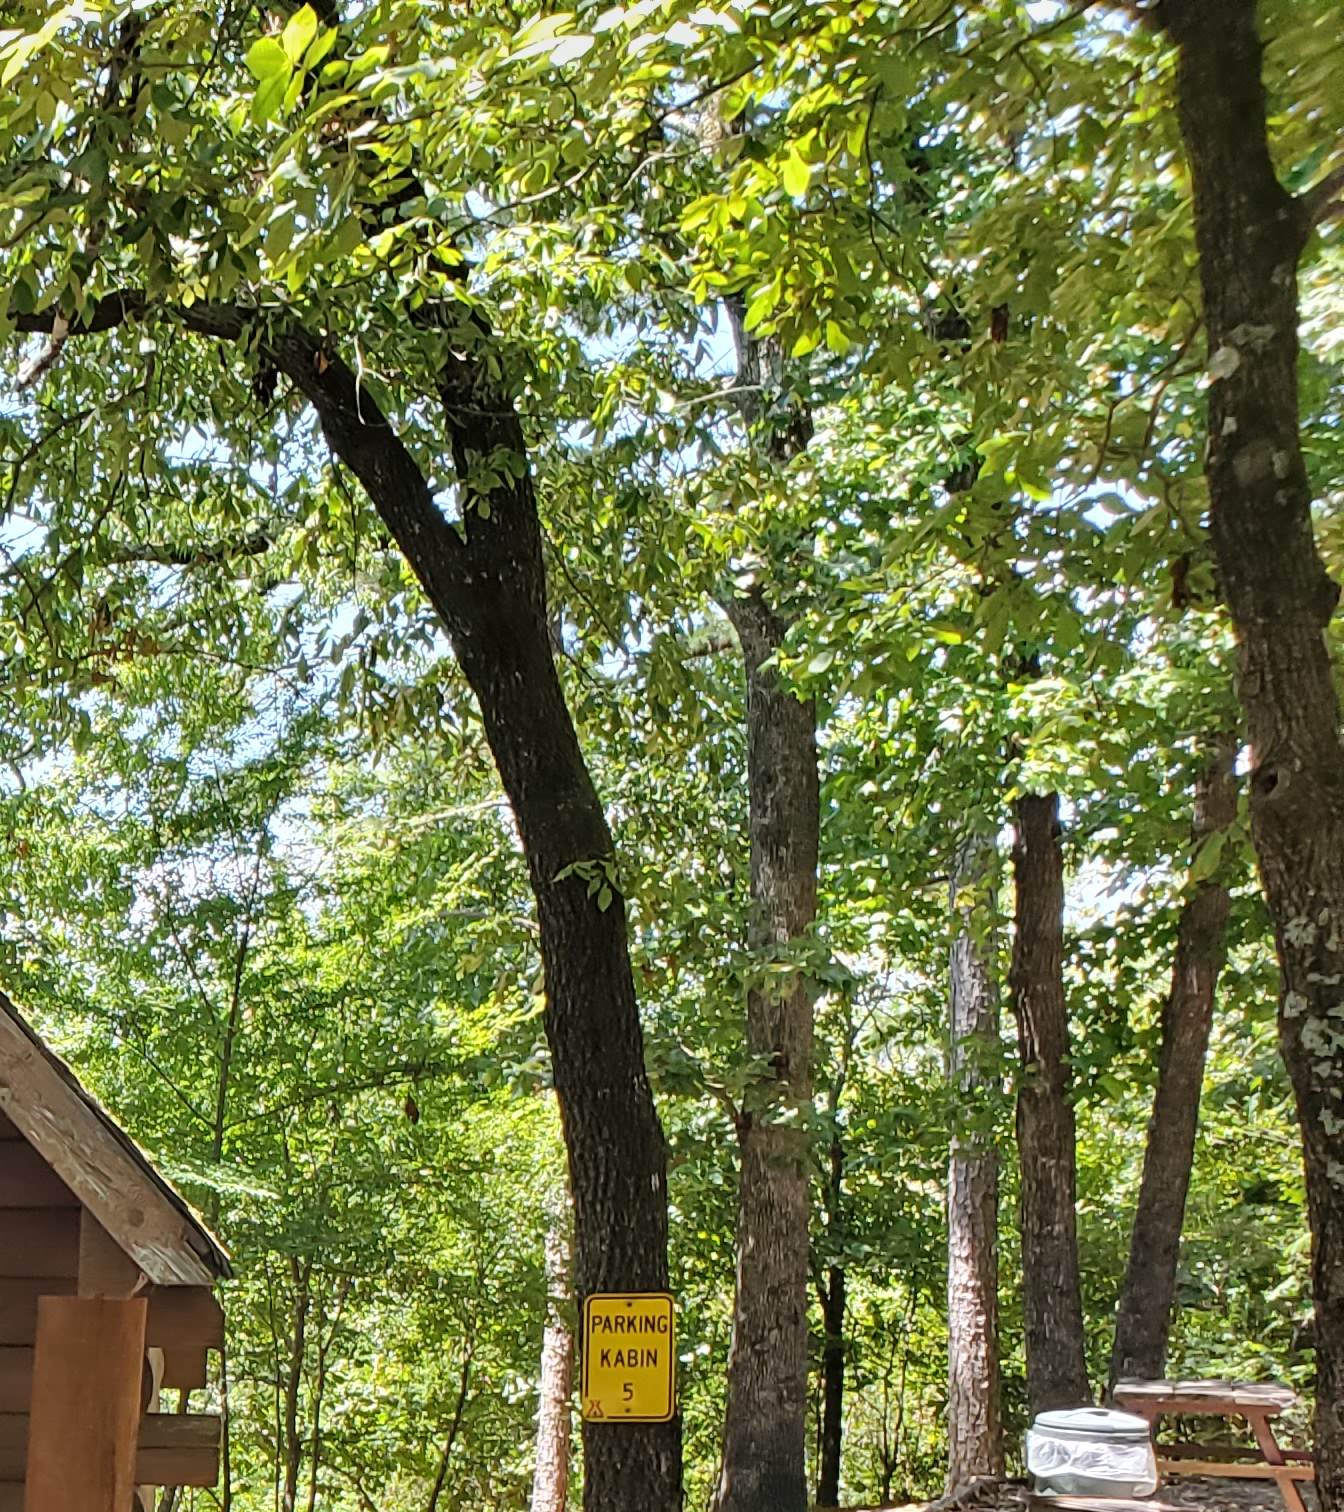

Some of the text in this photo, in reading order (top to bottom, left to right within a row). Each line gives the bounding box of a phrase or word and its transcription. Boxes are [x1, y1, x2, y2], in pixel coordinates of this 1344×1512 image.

[592, 1315, 668, 1334] PARKING
[601, 1348, 658, 1368] KABIN
[622, 1382, 633, 1401] 5
